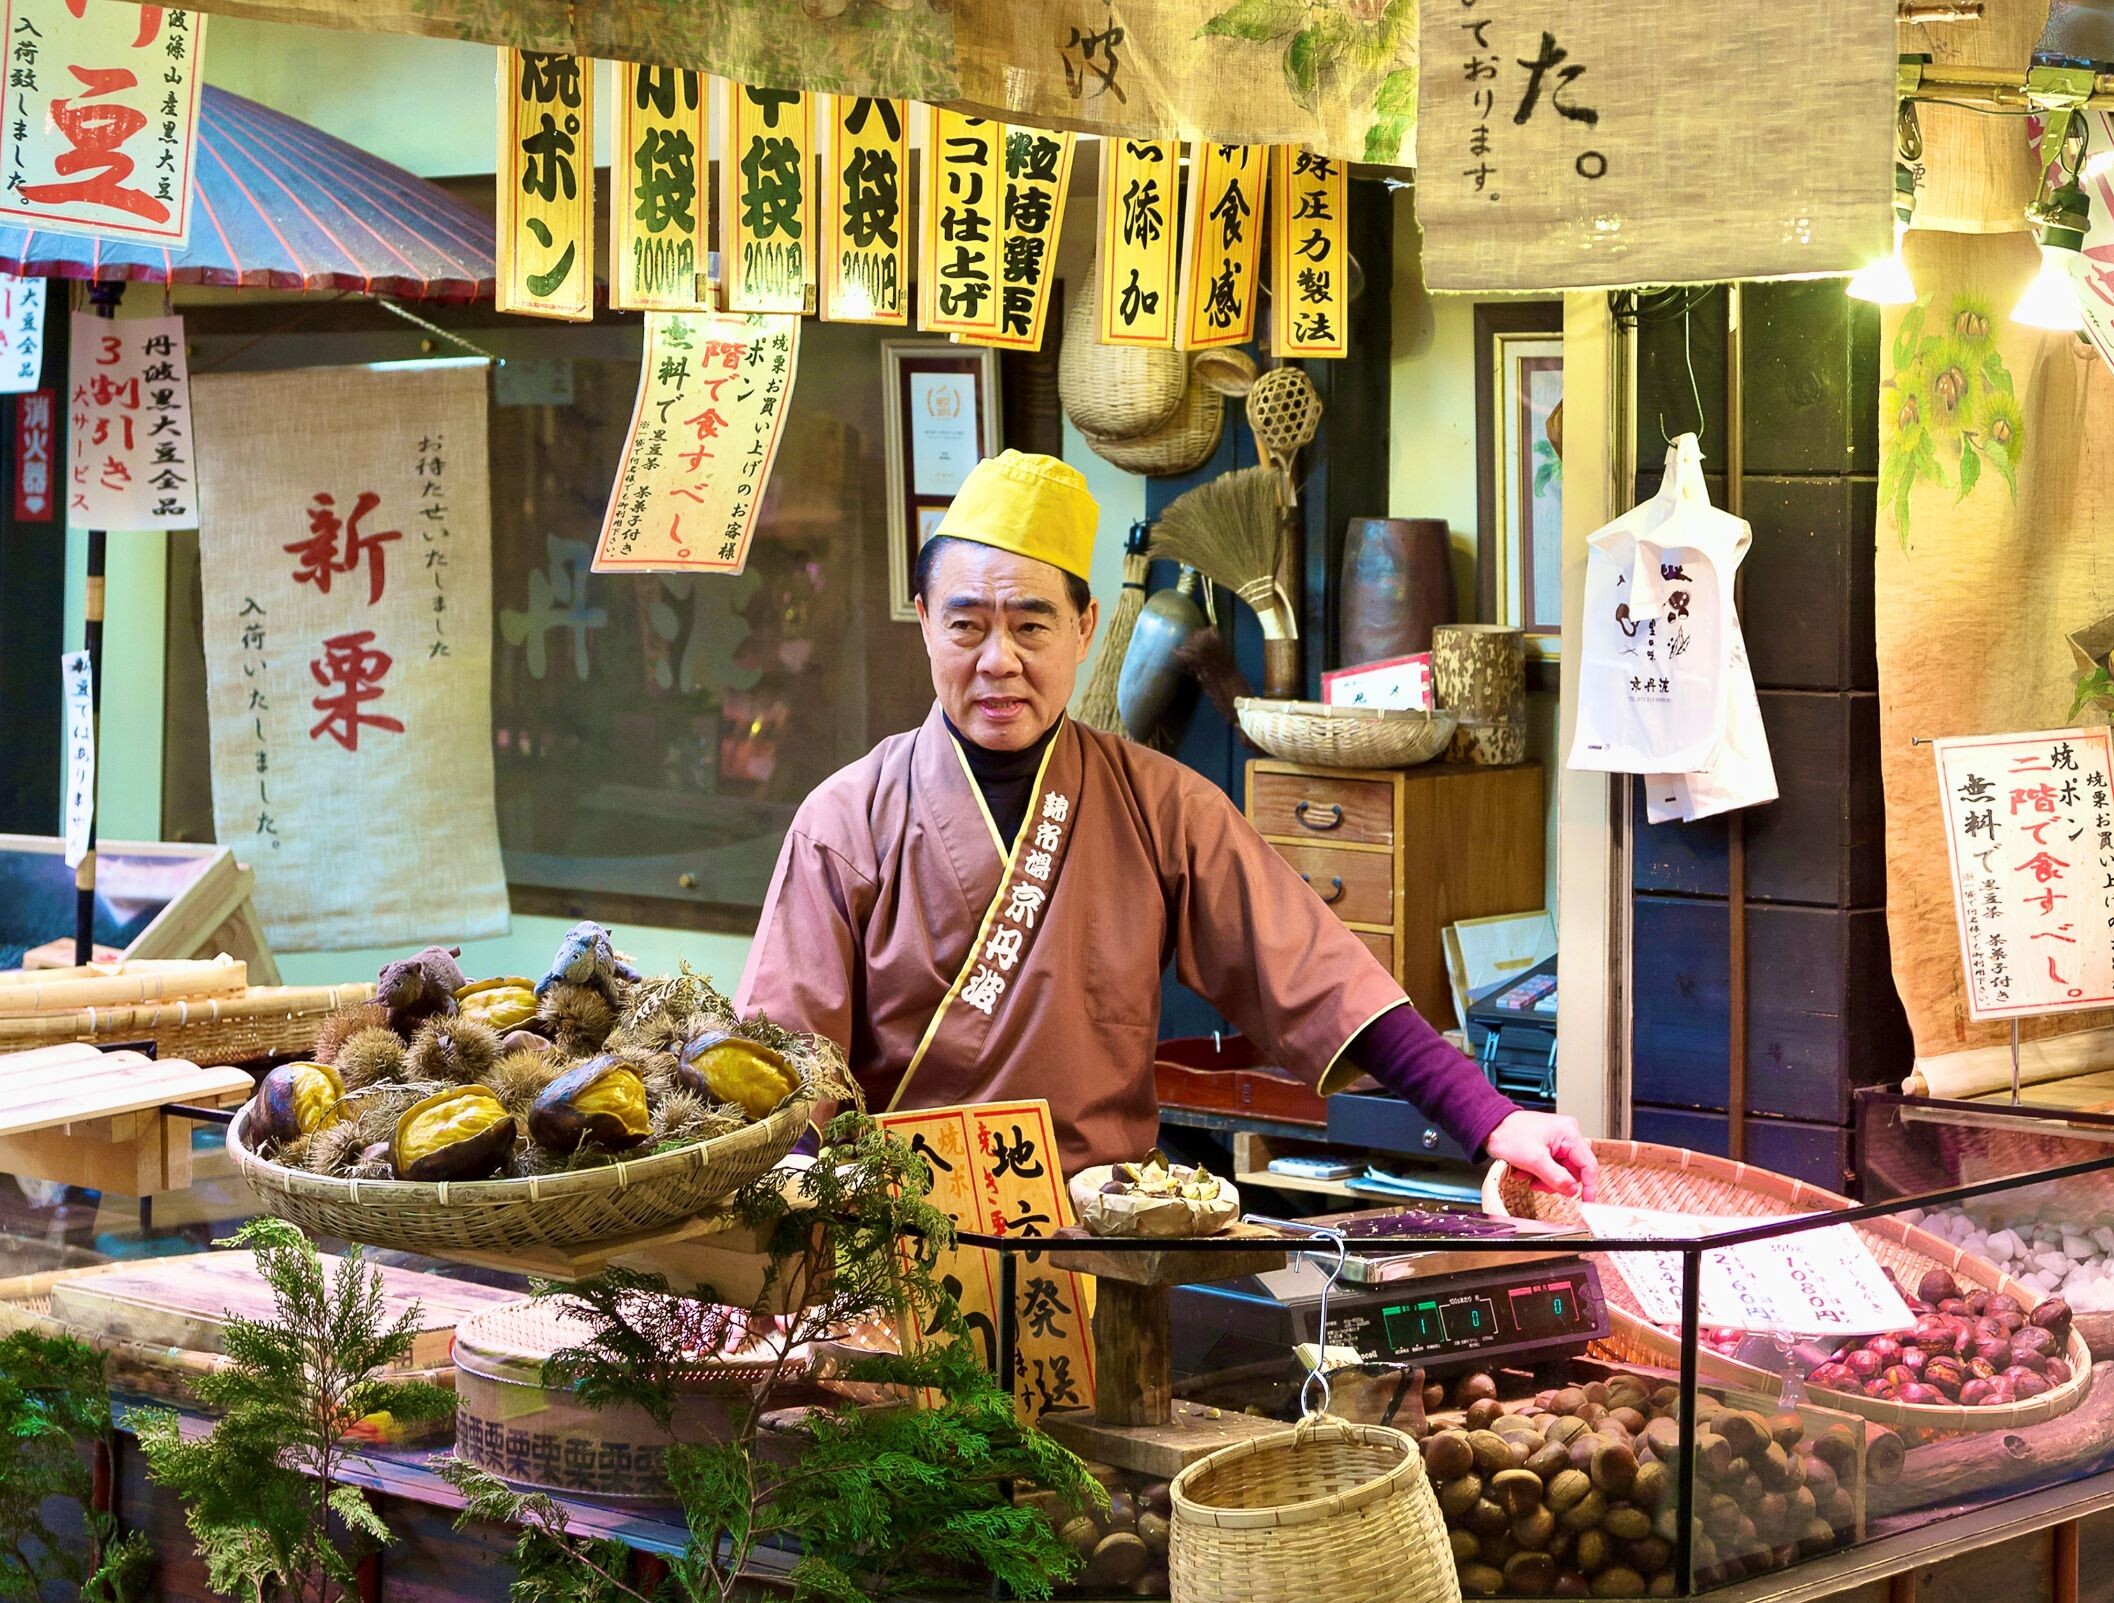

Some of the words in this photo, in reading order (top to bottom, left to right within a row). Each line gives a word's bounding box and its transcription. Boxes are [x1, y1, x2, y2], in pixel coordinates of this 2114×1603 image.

[7, 17, 43, 206] 入荷致しました。
[17, 0, 170, 224] 豆
[1460, 0, 1500, 201] ております。
[1512, 31, 1609, 179] た。
[938, 117, 991, 319] コリ仕上げ
[1001, 129, 1063, 336] 粒特撰栗
[16, 276, 40, 378] 大豆全品
[90, 336, 141, 491] 3割引き
[23, 396, 50, 495] 消火器
[70, 385, 91, 512] 大サービス
[141, 334, 188, 516] 丹波黒大豆全品
[717, 332, 789, 561] 焼栗お買い上げのお客様
[283, 490, 405, 752] 新栗
[416, 432, 451, 659] お待たせいたしました
[240, 596, 281, 850] 入荷いたしました。
[1629, 675, 1670, 694] 京丹波
[1957, 773, 2003, 874] 無料で
[2007, 755, 2083, 998] 二階で食すべし。
[2050, 742, 2085, 841] 焼ポン
[1471, 1309, 1480, 1327] 0
[1552, 1298, 1562, 1315] 0
